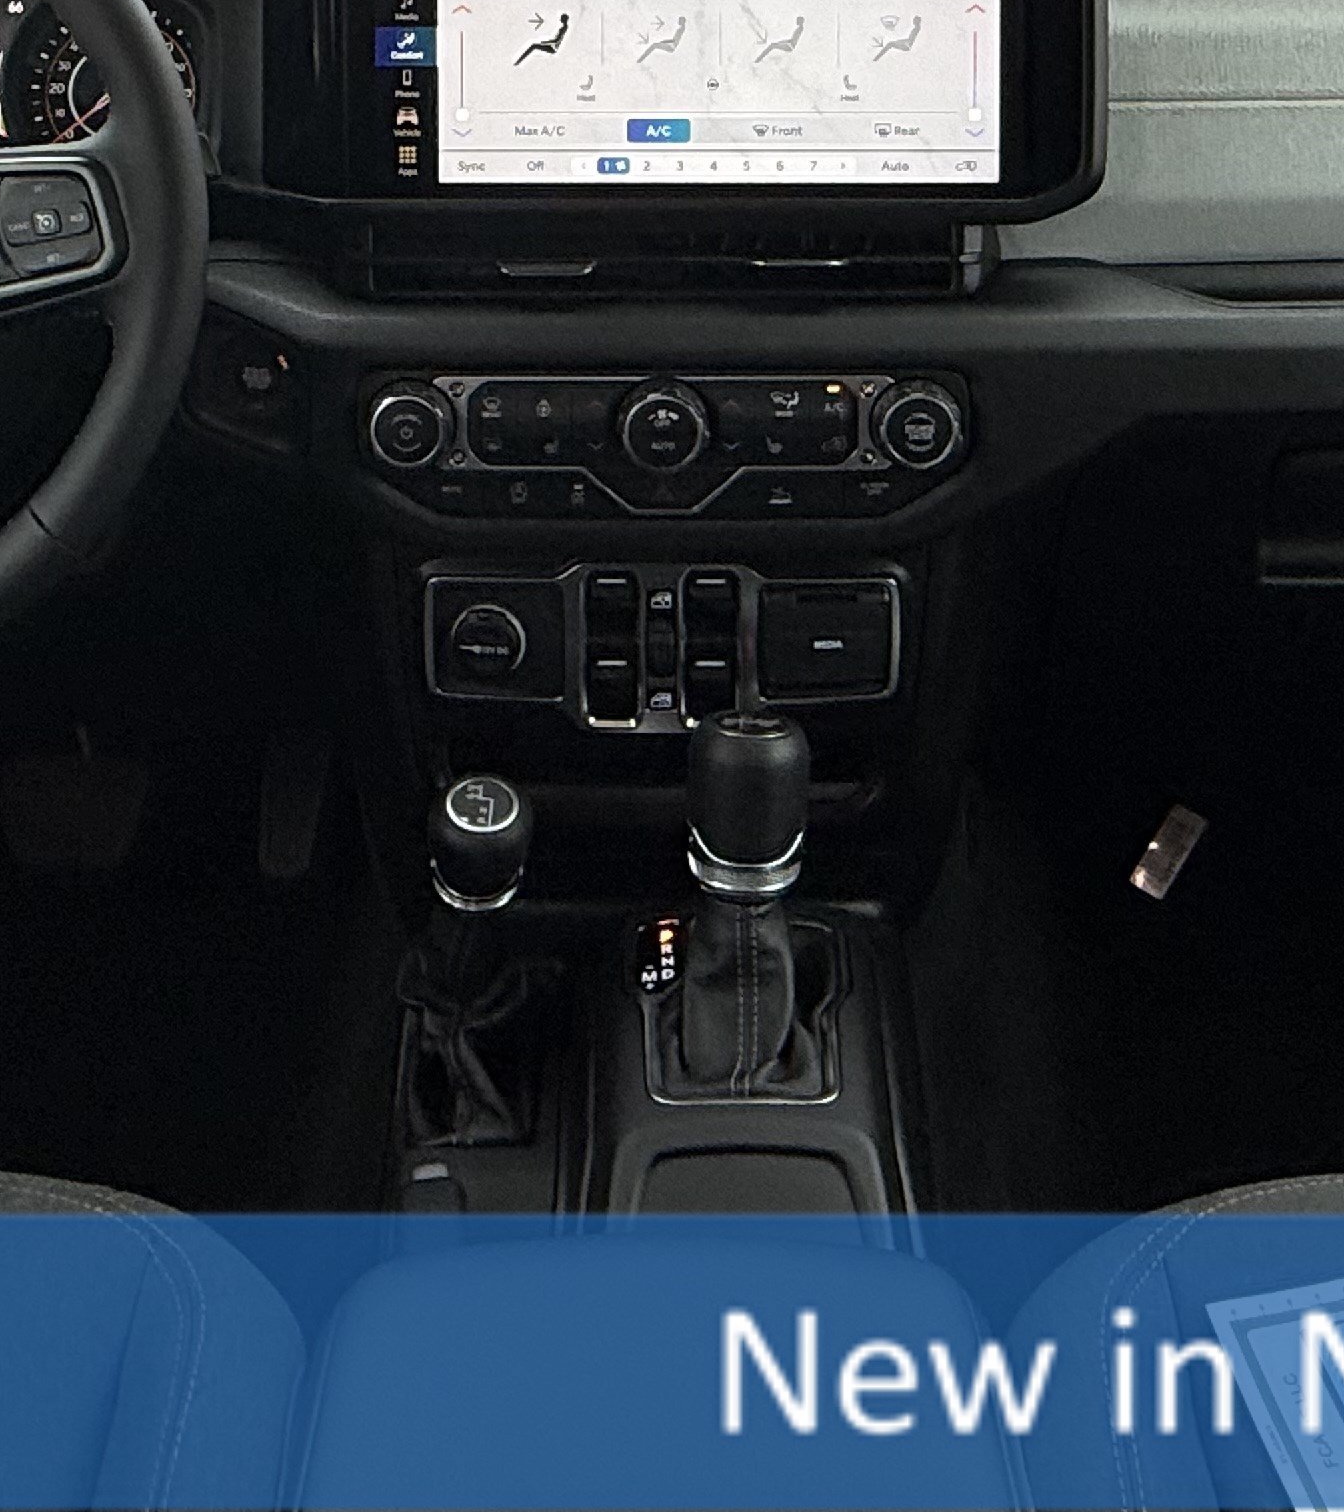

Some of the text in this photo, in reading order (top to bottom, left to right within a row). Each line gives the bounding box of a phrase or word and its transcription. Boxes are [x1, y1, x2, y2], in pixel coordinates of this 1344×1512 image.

[540, 126, 566, 136] A/C
[646, 124, 672, 137] A/C
[772, 124, 803, 136] Front
[894, 125, 920, 136] Rear
[458, 160, 486, 173] Sync
[526, 161, 544, 171] Off
[643, 161, 650, 172] 2
[676, 161, 684, 172] 3
[710, 161, 718, 172] 4
[742, 161, 750, 172] 5
[776, 161, 784, 172] 6
[810, 161, 818, 172] 7
[881, 161, 910, 172] Auto
[659, 928, 674, 943] P
[660, 956, 676, 966] N
[641, 971, 658, 983] M
[660, 968, 676, 980] D
[1311, 1432, 1339, 1471] FCA
